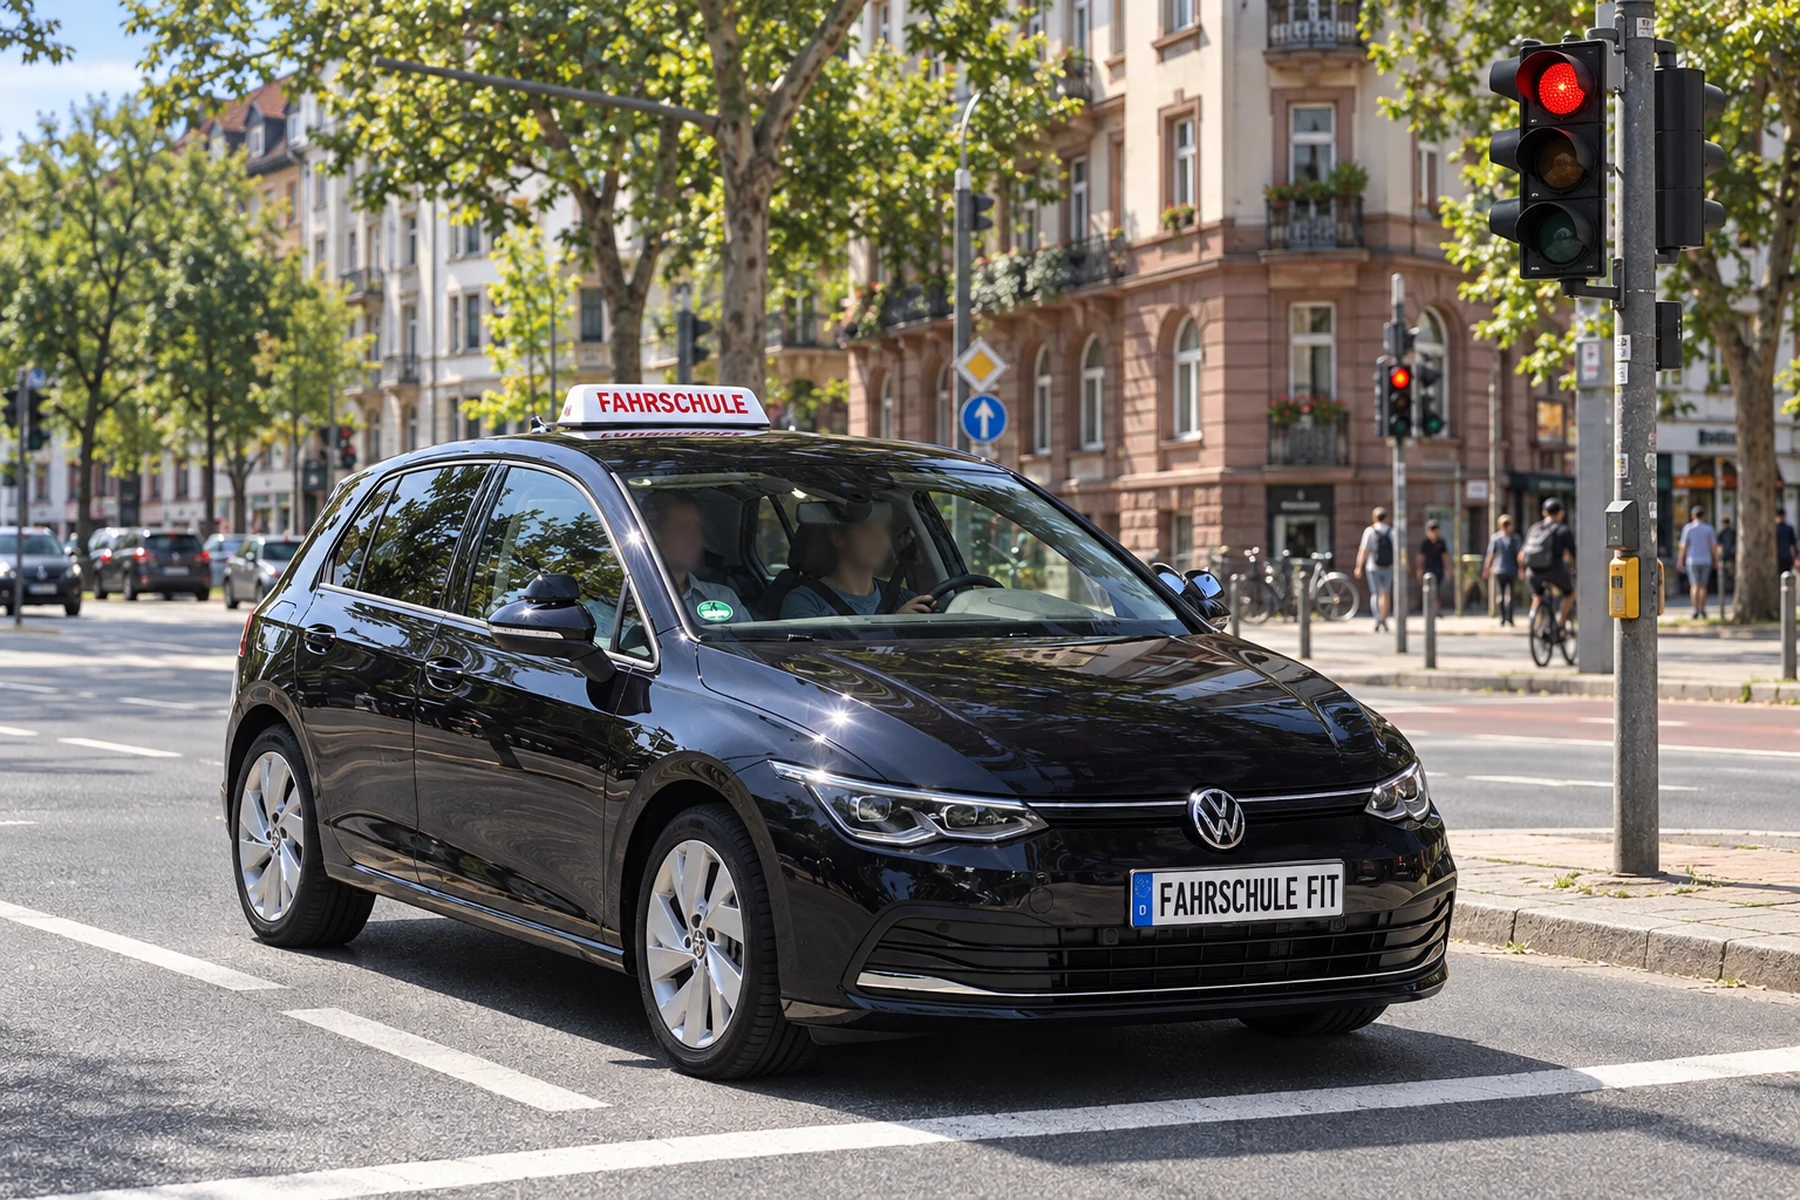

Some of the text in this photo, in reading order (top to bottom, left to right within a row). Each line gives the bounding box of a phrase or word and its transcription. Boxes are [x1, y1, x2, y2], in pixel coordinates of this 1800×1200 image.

[597, 392, 749, 414] FAHRSCHULE
[1194, 788, 1243, 848] VW
[1139, 874, 1339, 917] D FAHRSCHULE FIT
